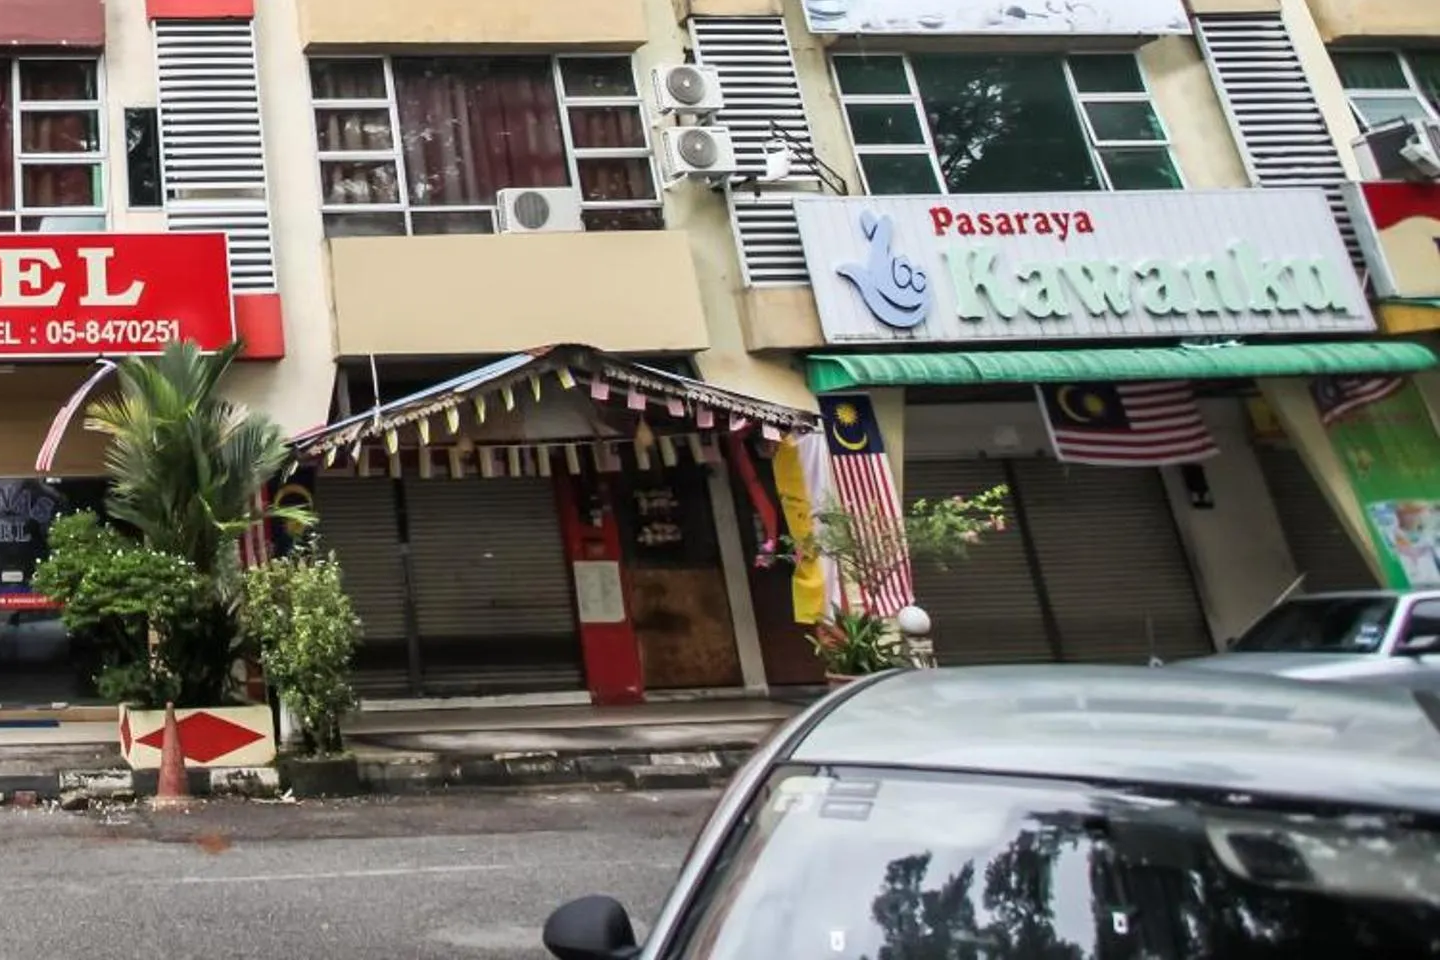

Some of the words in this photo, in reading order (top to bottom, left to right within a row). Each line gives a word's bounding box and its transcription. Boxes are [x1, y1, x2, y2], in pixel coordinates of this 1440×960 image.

[929, 206, 1095, 241] Pasaraya
[941, 238, 1351, 323] Kawanku
[45, 319, 181, 344] 05-8470251
